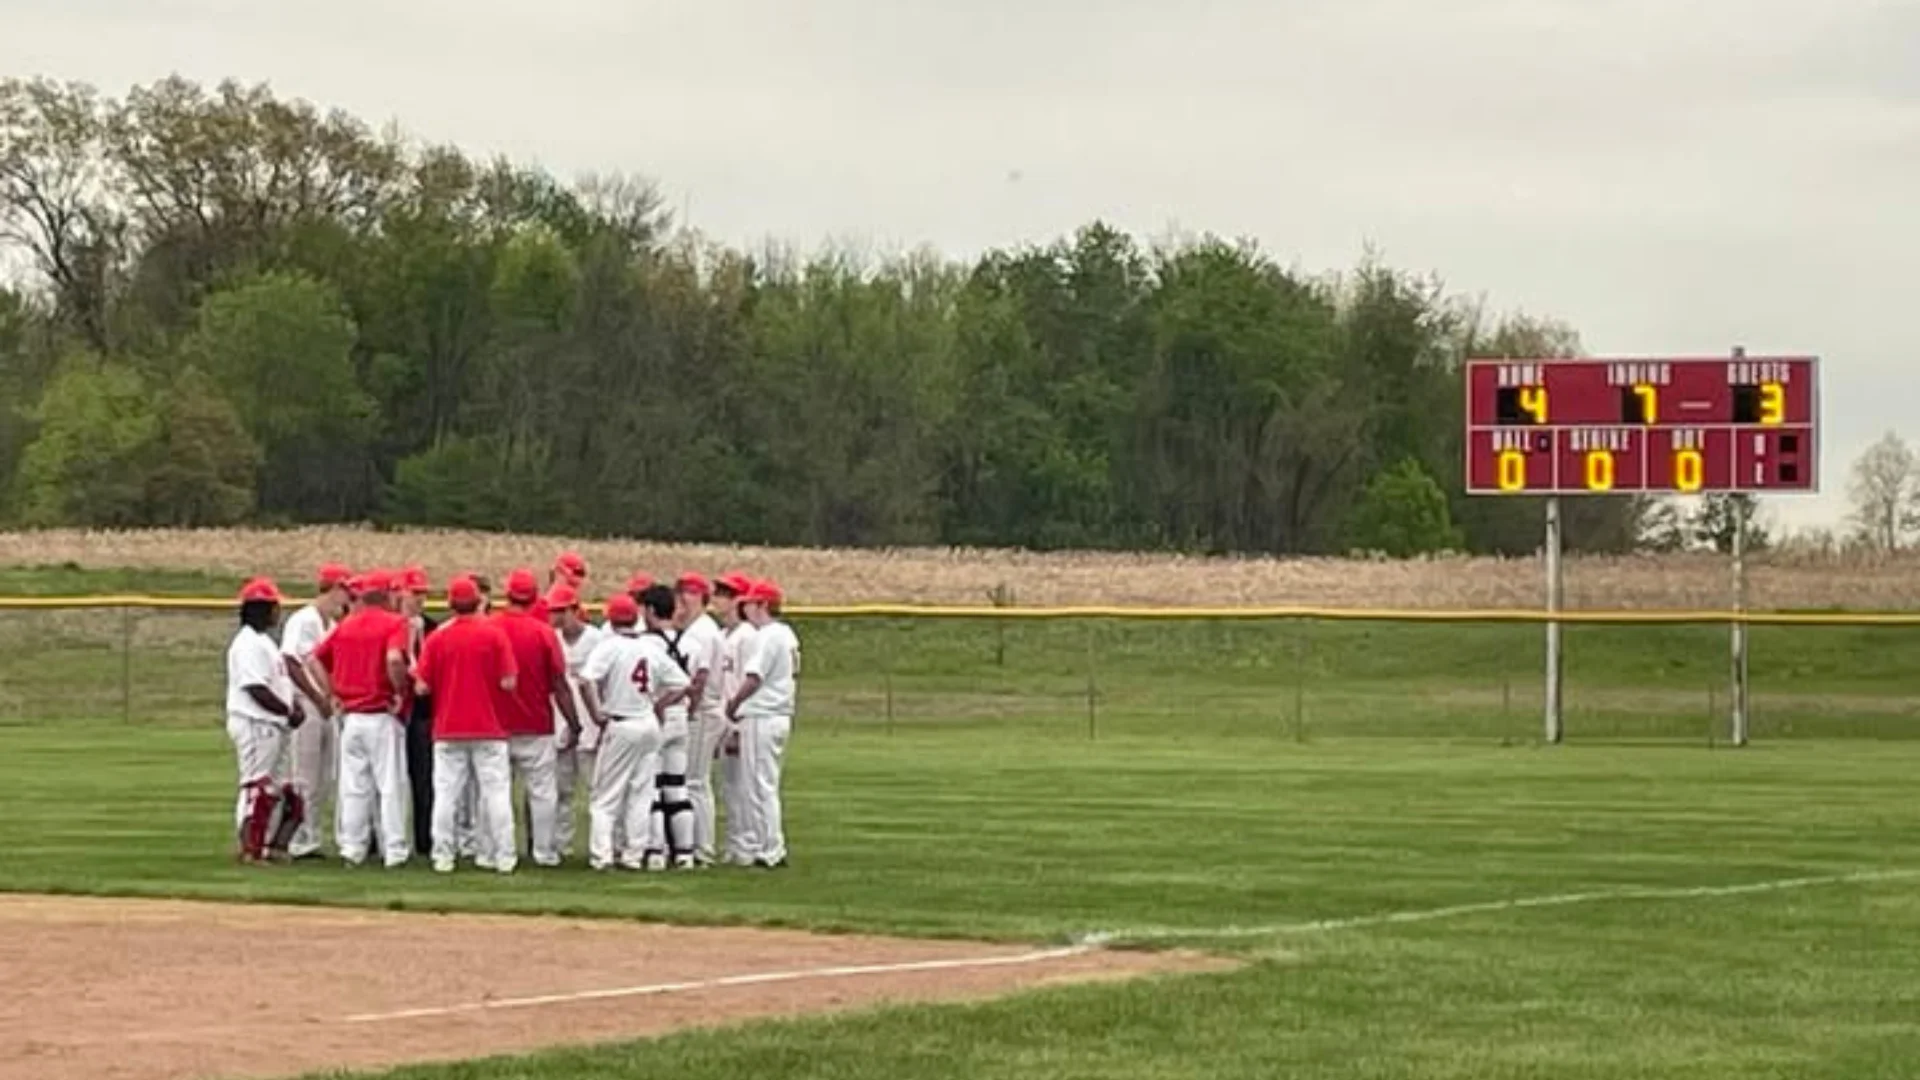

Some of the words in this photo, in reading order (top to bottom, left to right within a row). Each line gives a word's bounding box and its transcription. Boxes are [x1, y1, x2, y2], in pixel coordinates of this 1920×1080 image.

[1608, 364, 1670, 385] INNING
[1728, 363, 1790, 384] GUESTS
[1520, 386, 1547, 423] 4
[1633, 384, 1658, 424] 7
[1760, 383, 1785, 424] 3
[1499, 450, 1525, 490] 0
[1587, 450, 1613, 490] 0
[1676, 450, 1703, 491] 0
[631, 658, 650, 692] 4
